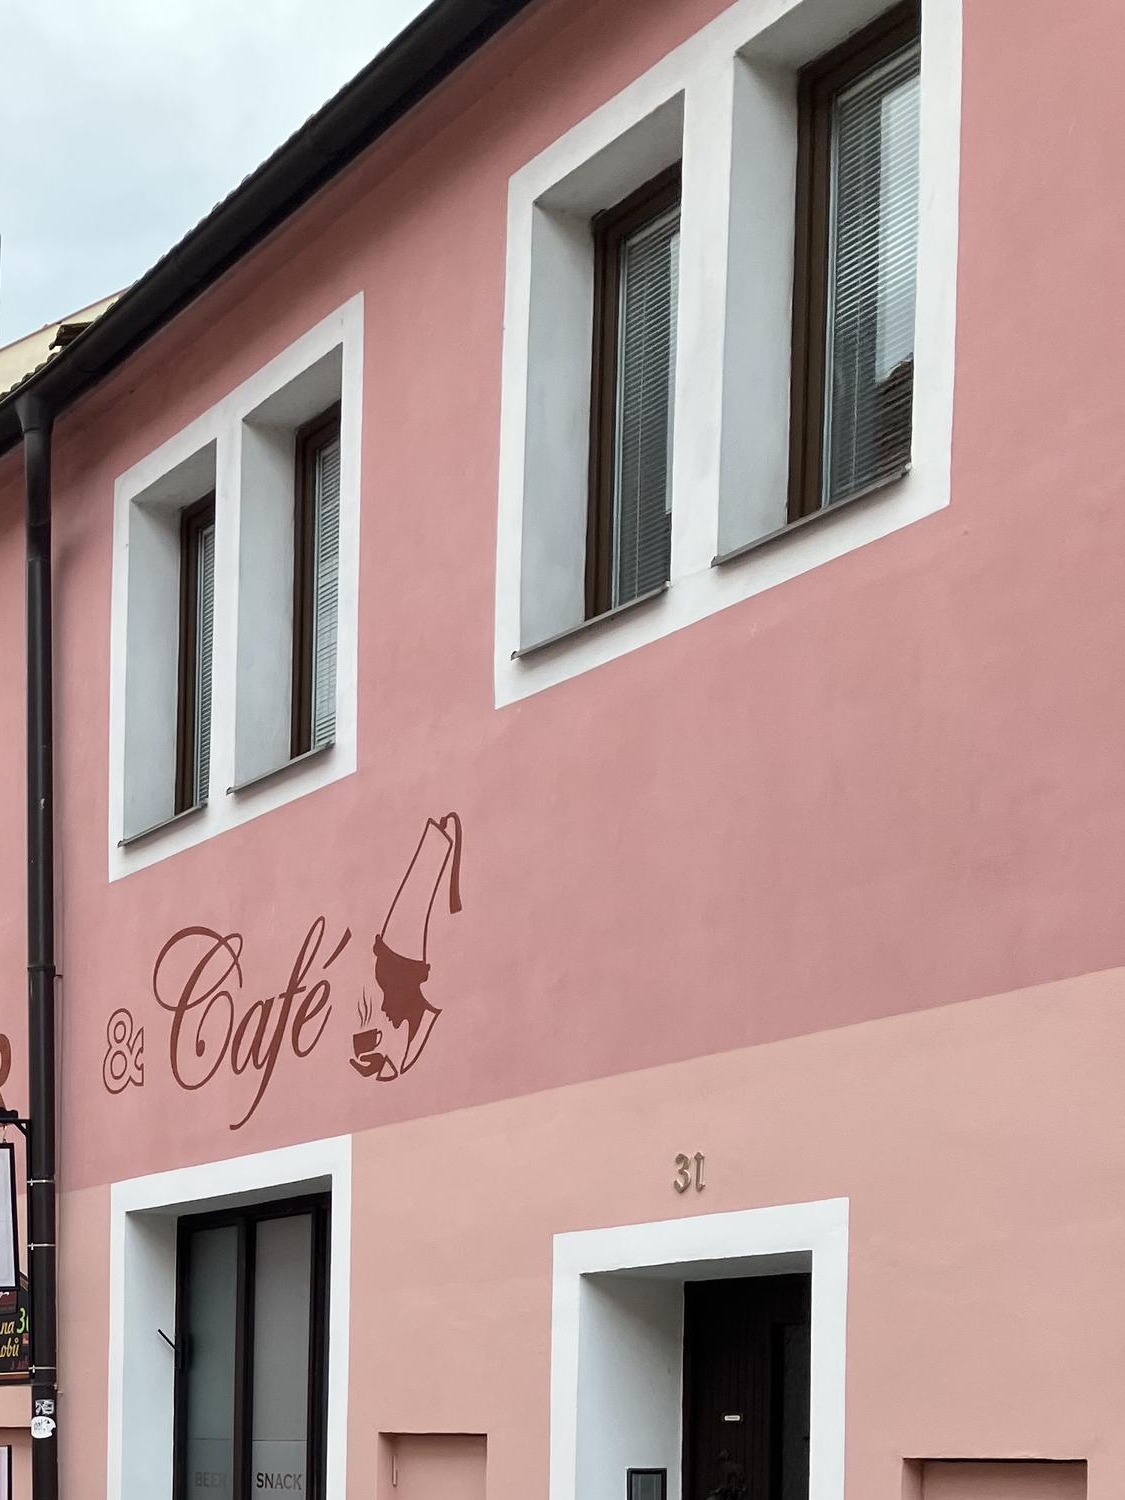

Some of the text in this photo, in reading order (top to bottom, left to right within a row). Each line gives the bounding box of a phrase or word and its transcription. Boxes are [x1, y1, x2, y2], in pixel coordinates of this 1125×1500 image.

[102, 1007, 145, 1095] &
[152, 915, 353, 1131] Café
[673, 1151, 706, 1194] 31
[0, 1321, 16, 1335] na
[194, 1471, 303, 1490] BEER SNACK
